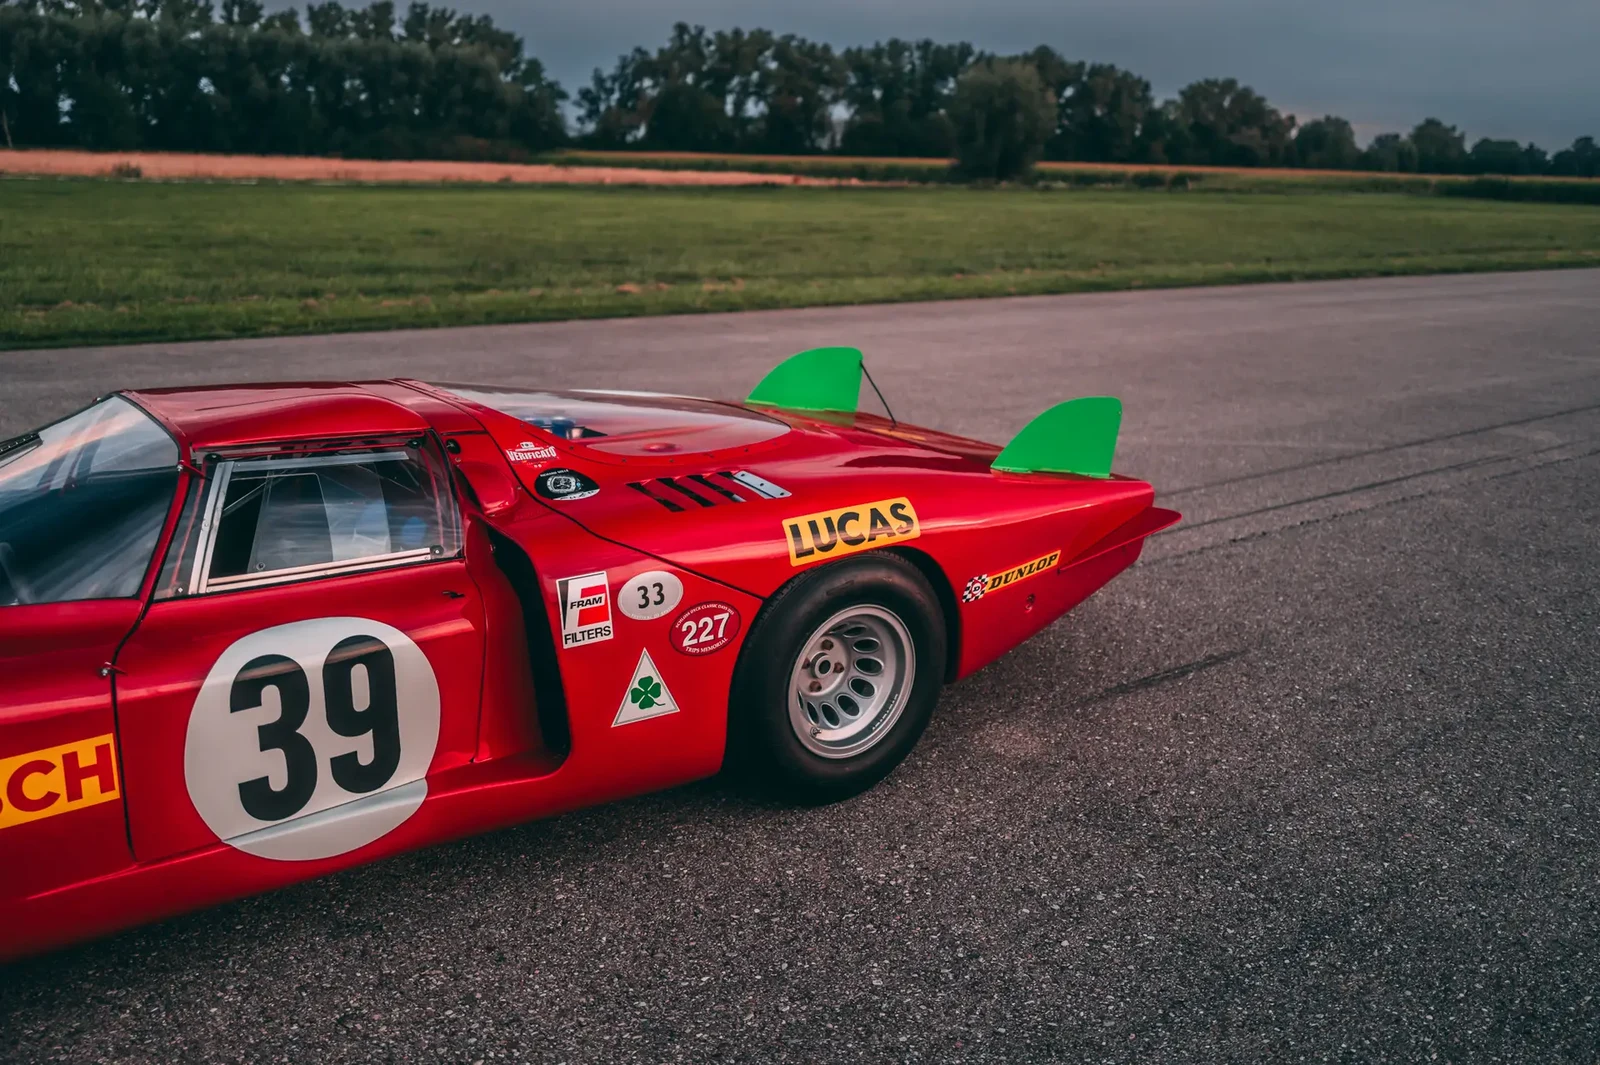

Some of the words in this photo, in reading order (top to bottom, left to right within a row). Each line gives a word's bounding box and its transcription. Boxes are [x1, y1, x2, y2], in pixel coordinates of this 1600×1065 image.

[506, 445, 556, 461] VERIFICATO
[789, 503, 914, 559] LUCAS
[988, 553, 1058, 590] DUNLOP
[570, 596, 603, 609] FRAM
[637, 582, 665, 609] 33
[564, 626, 612, 645] FILTERS
[681, 612, 730, 647] 227
[700, 637, 729, 653] MEMORIAL
[228, 634, 401, 822] 39
[0, 743, 116, 812] CH
